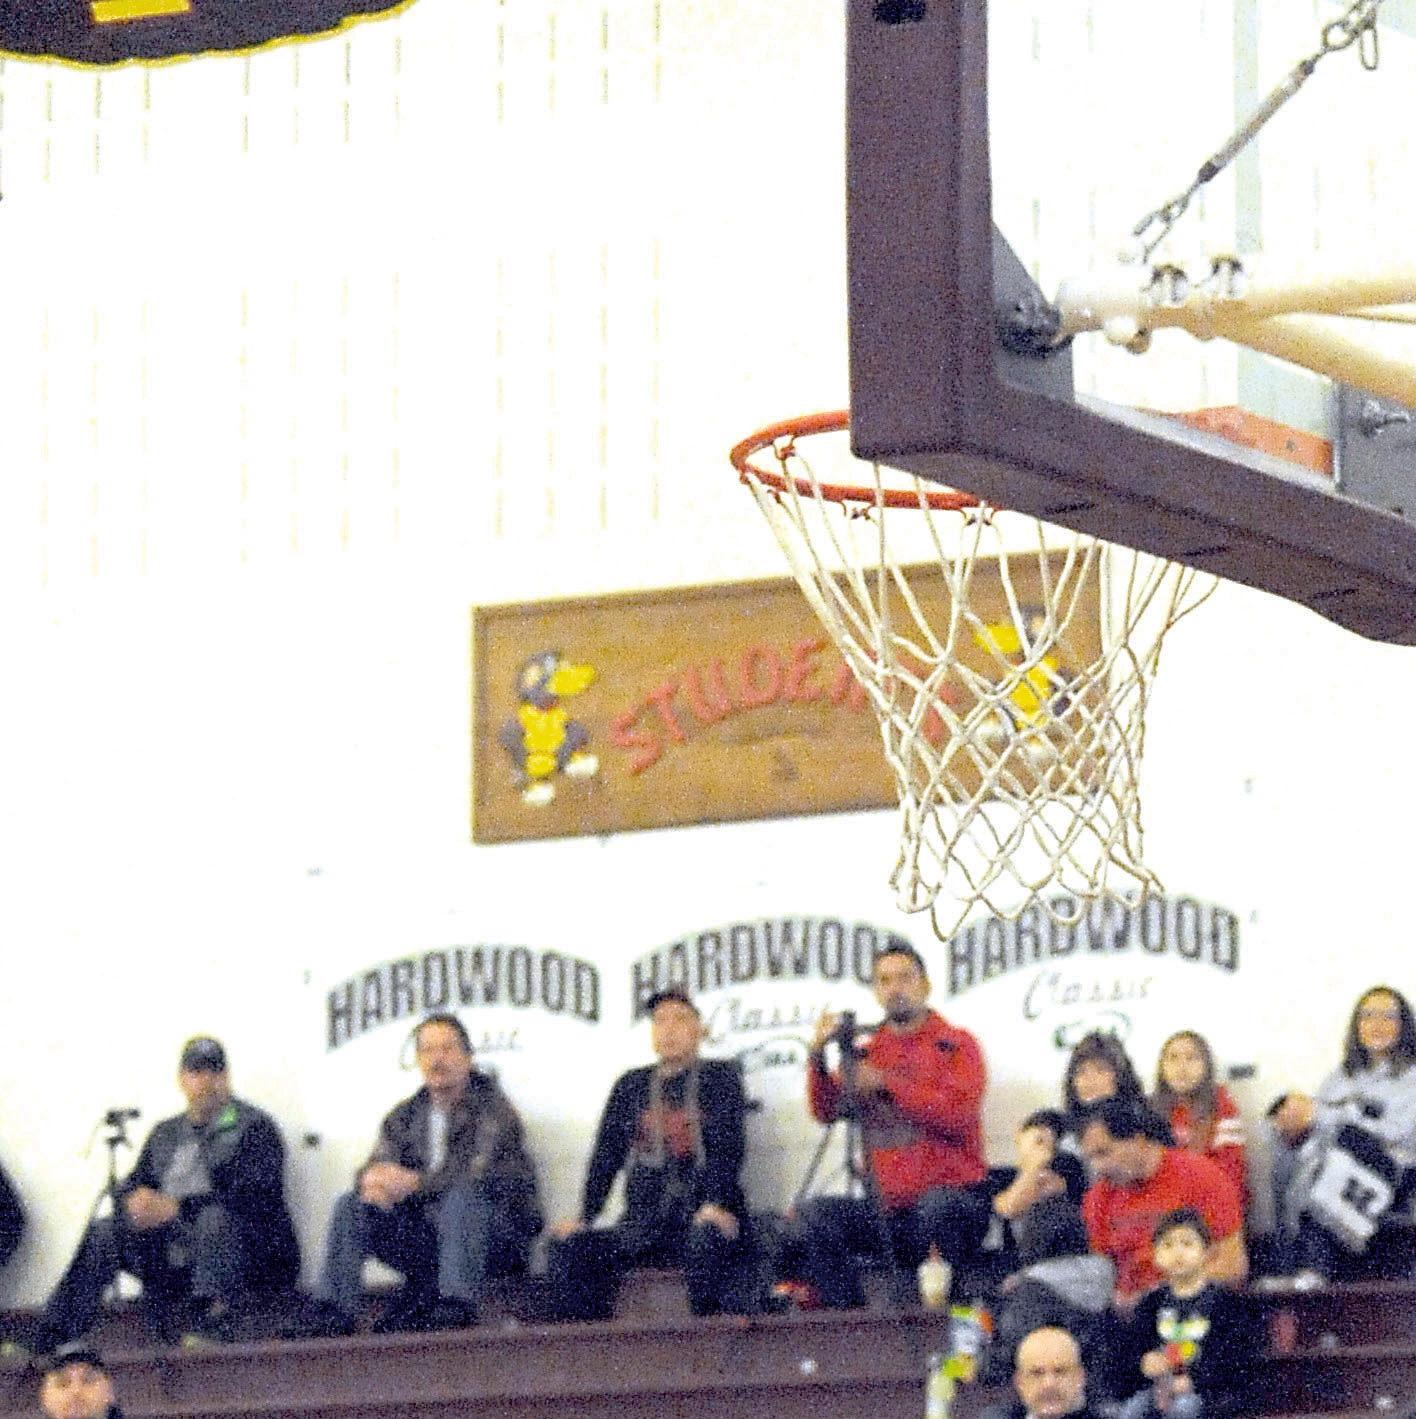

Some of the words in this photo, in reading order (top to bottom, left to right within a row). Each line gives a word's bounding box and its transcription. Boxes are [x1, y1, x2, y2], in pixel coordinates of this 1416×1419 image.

[630, 917, 914, 1026] HARDWOO
[947, 889, 1239, 998] HARDWOOD
[326, 945, 600, 1053] HARDWOOD
